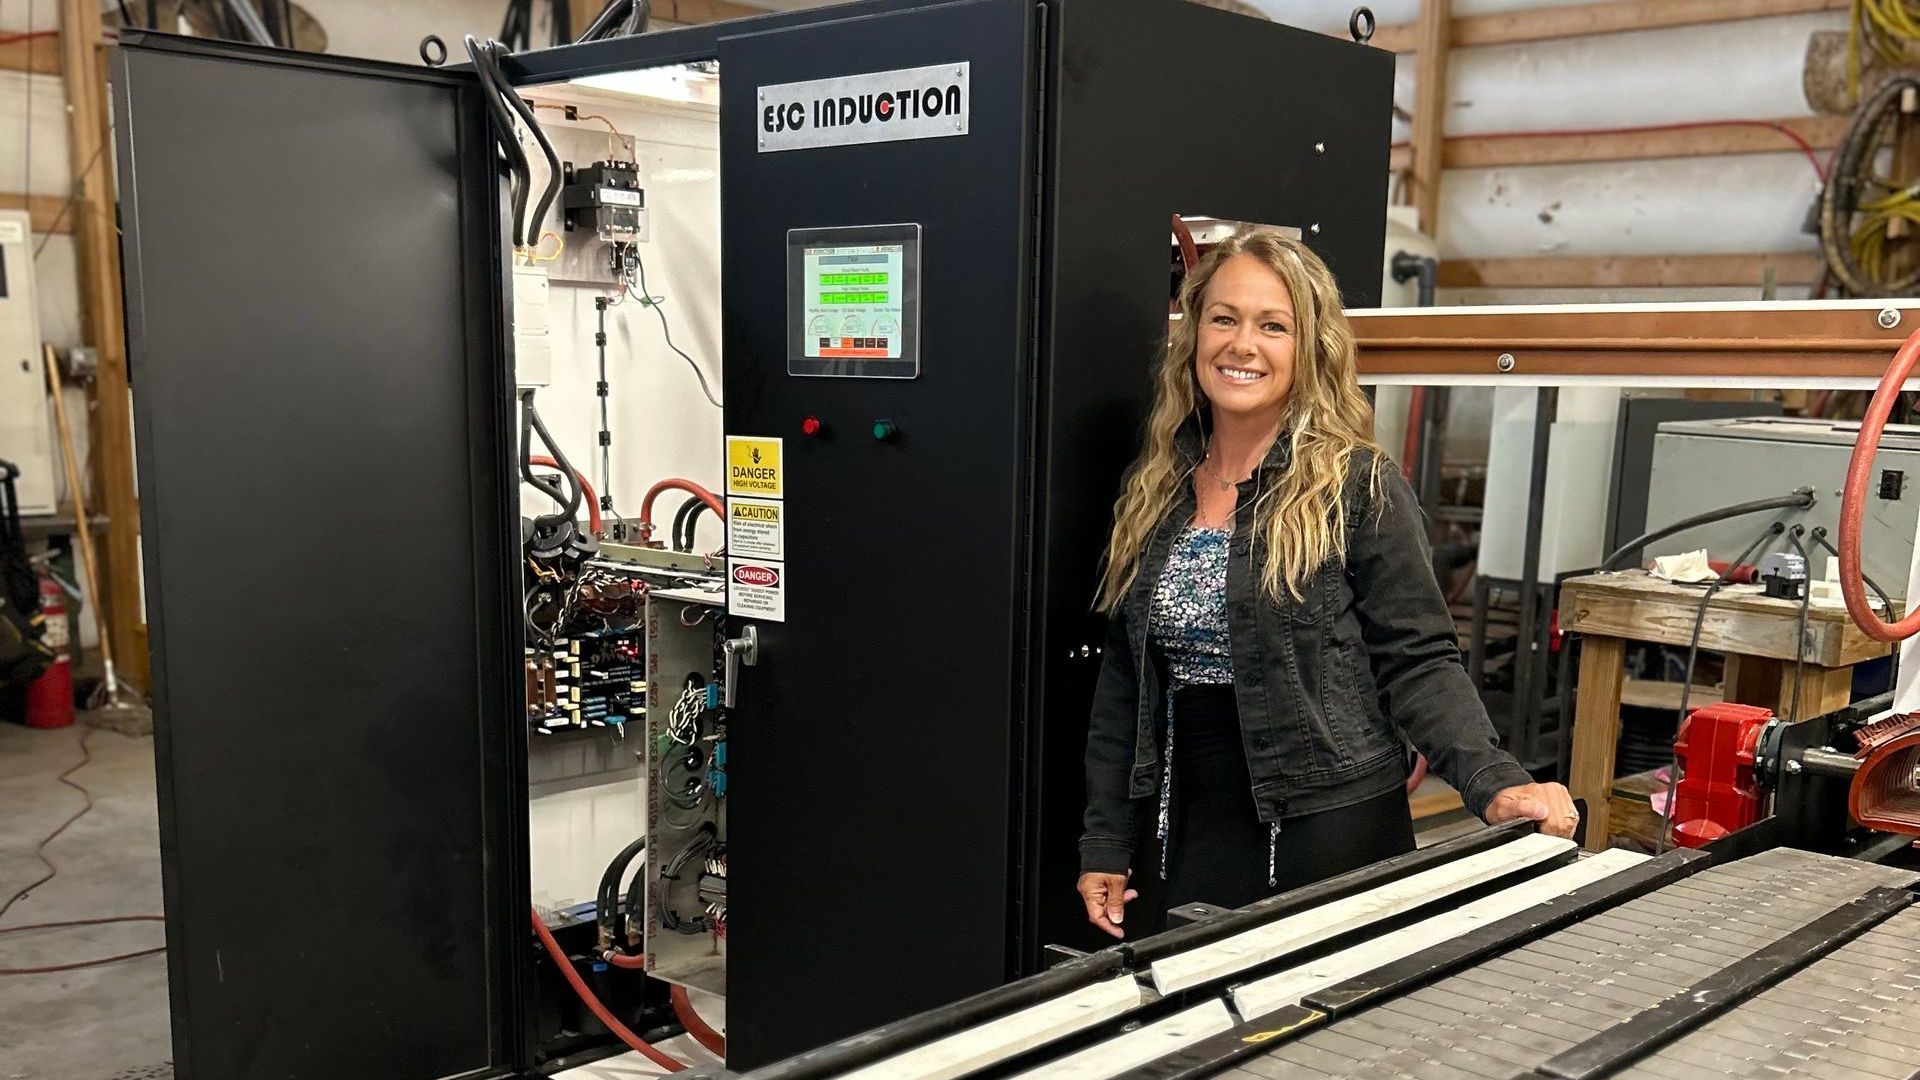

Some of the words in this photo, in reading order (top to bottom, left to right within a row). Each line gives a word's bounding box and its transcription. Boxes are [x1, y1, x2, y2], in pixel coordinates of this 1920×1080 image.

[763, 102, 805, 133] ESC
[813, 84, 961, 129] INDUCTION
[733, 466, 776, 480] DANGER
[733, 480, 748, 488] HIGH
[749, 481, 777, 490] VOLTAGE
[741, 507, 778, 520] CAUTION
[738, 569, 773, 582] DANGER
